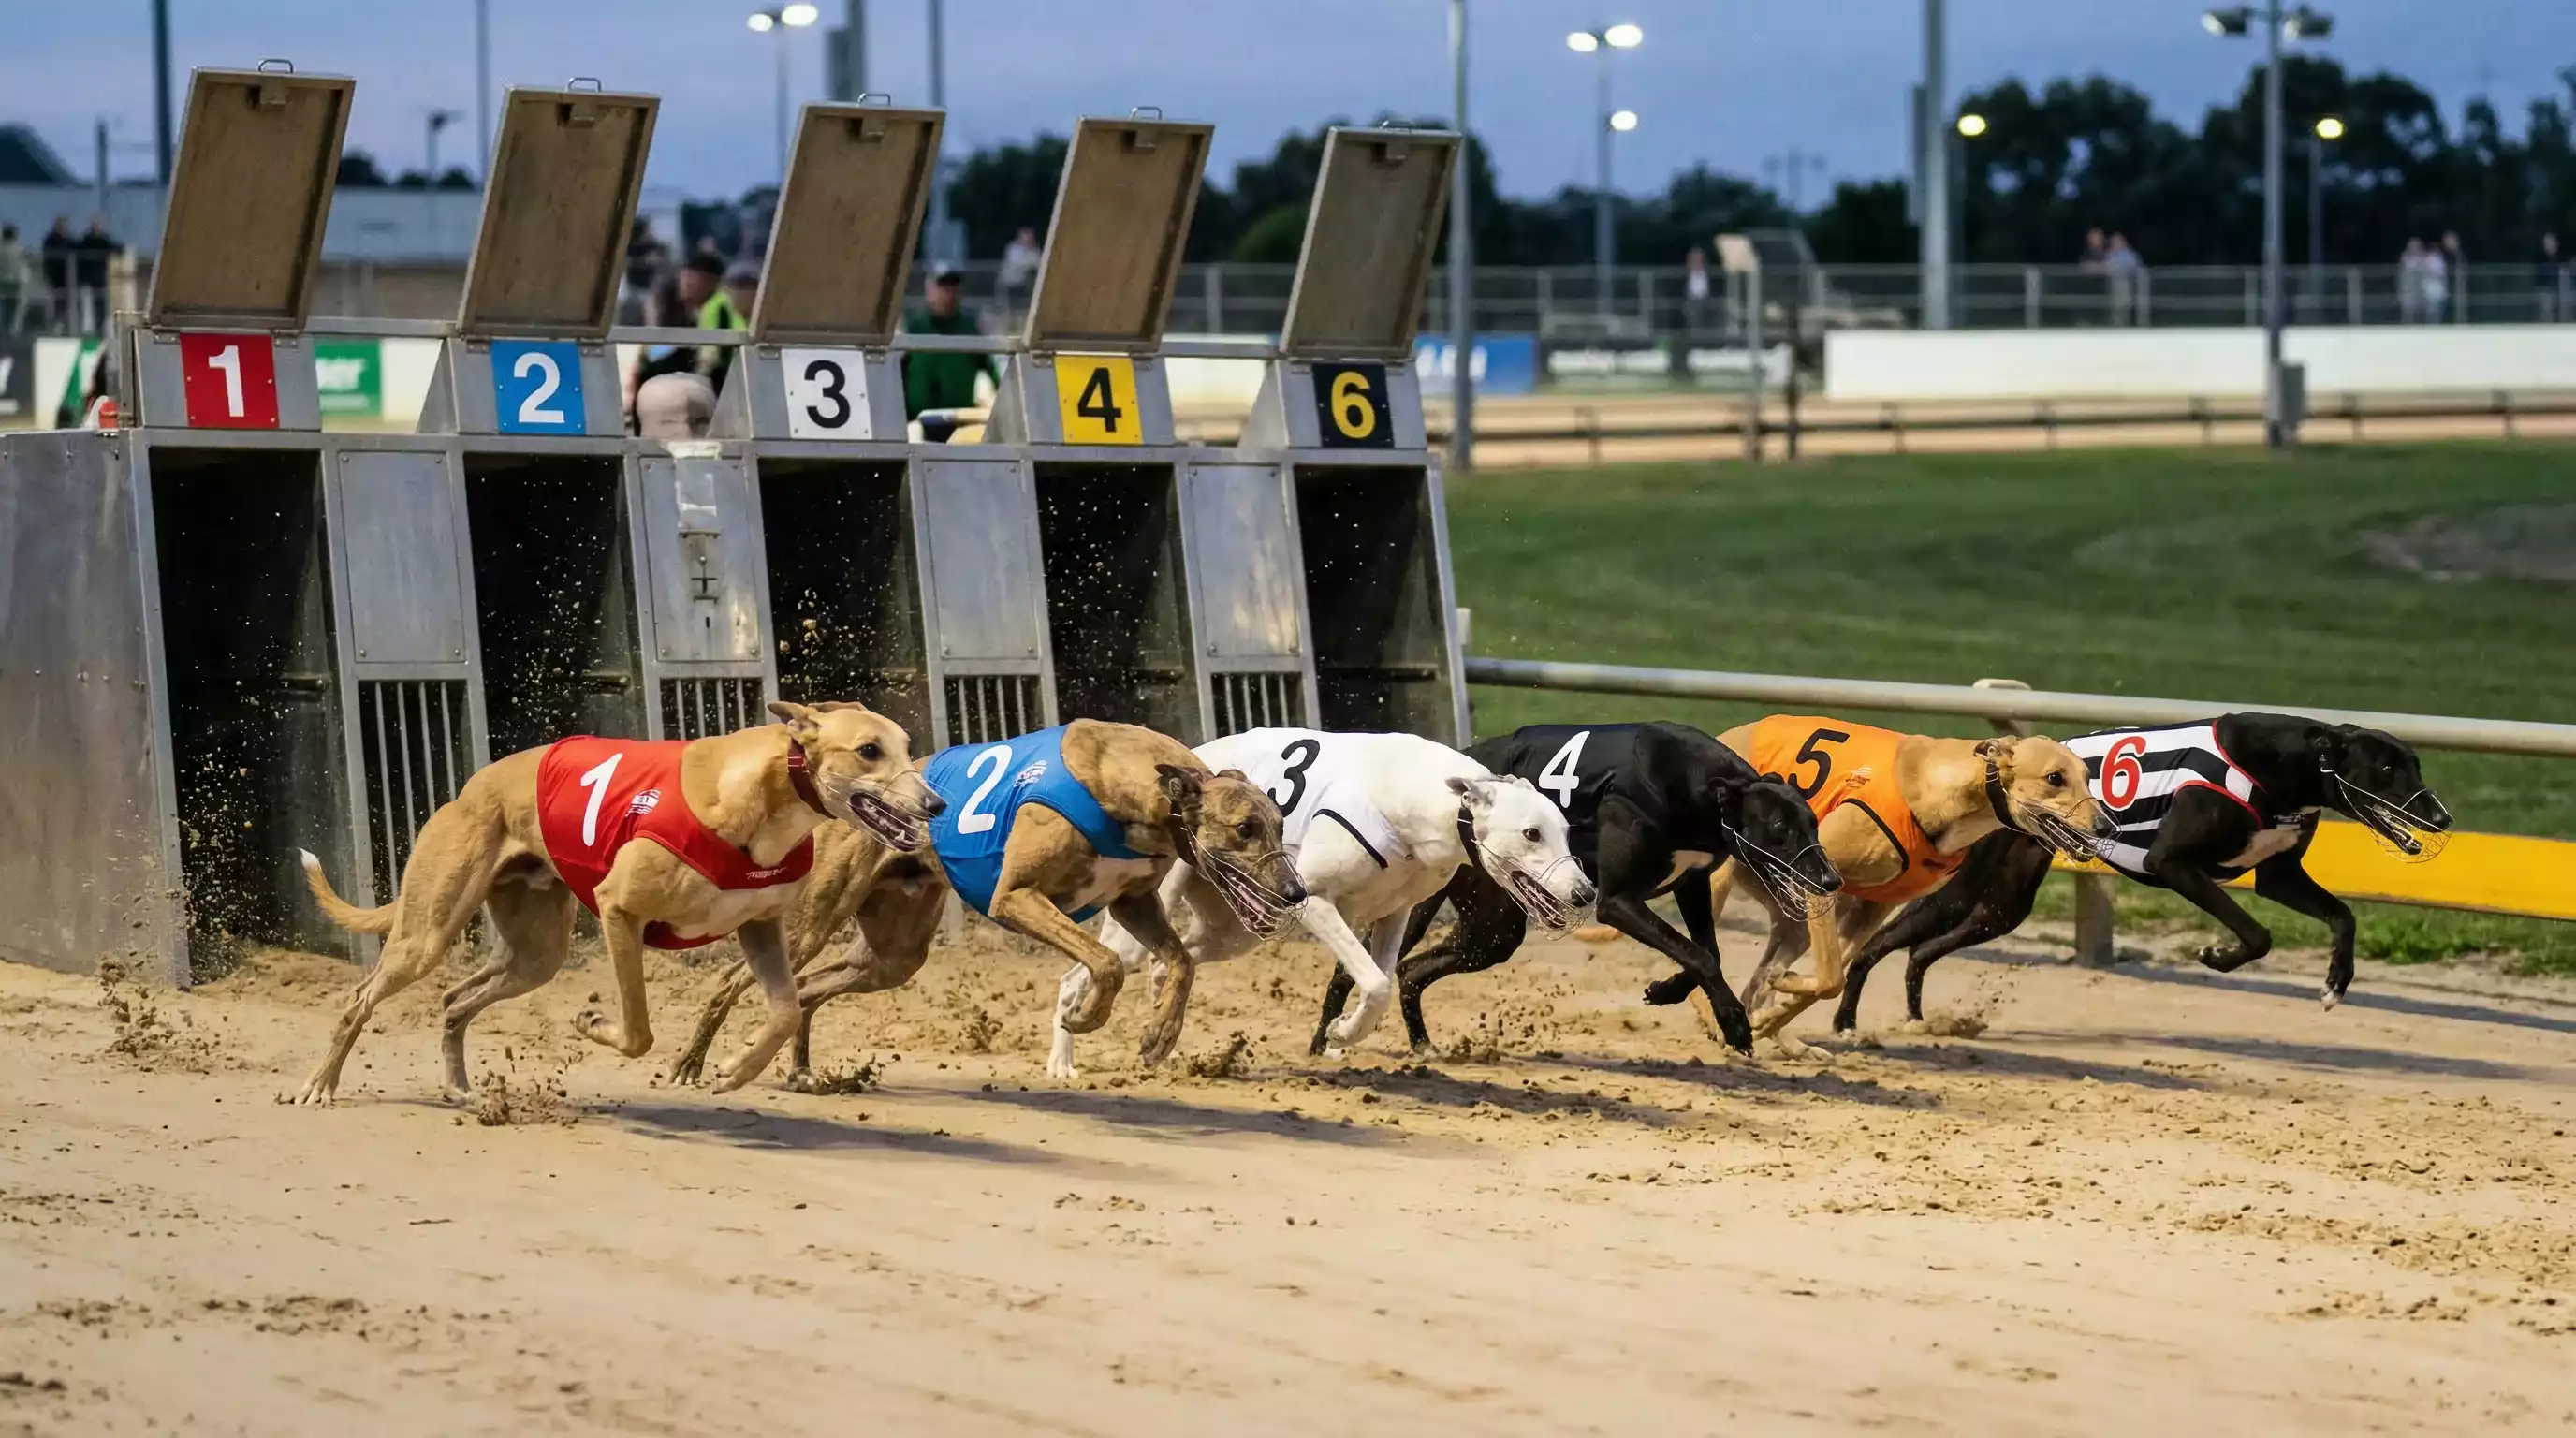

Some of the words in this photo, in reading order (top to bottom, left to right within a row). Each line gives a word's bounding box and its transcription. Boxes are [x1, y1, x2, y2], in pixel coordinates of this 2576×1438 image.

[209, 345, 243, 416] 1
[515, 353, 564, 423] 2
[804, 360, 850, 428] 3
[1078, 368, 1121, 432] 4
[1332, 373, 1374, 438] 6
[581, 754, 623, 845] 1
[958, 745, 1012, 834] 2
[1267, 739, 1320, 817] 3
[1539, 730, 1590, 809] 4
[1787, 727, 1851, 800] 5
[2100, 735, 2146, 809] 6
